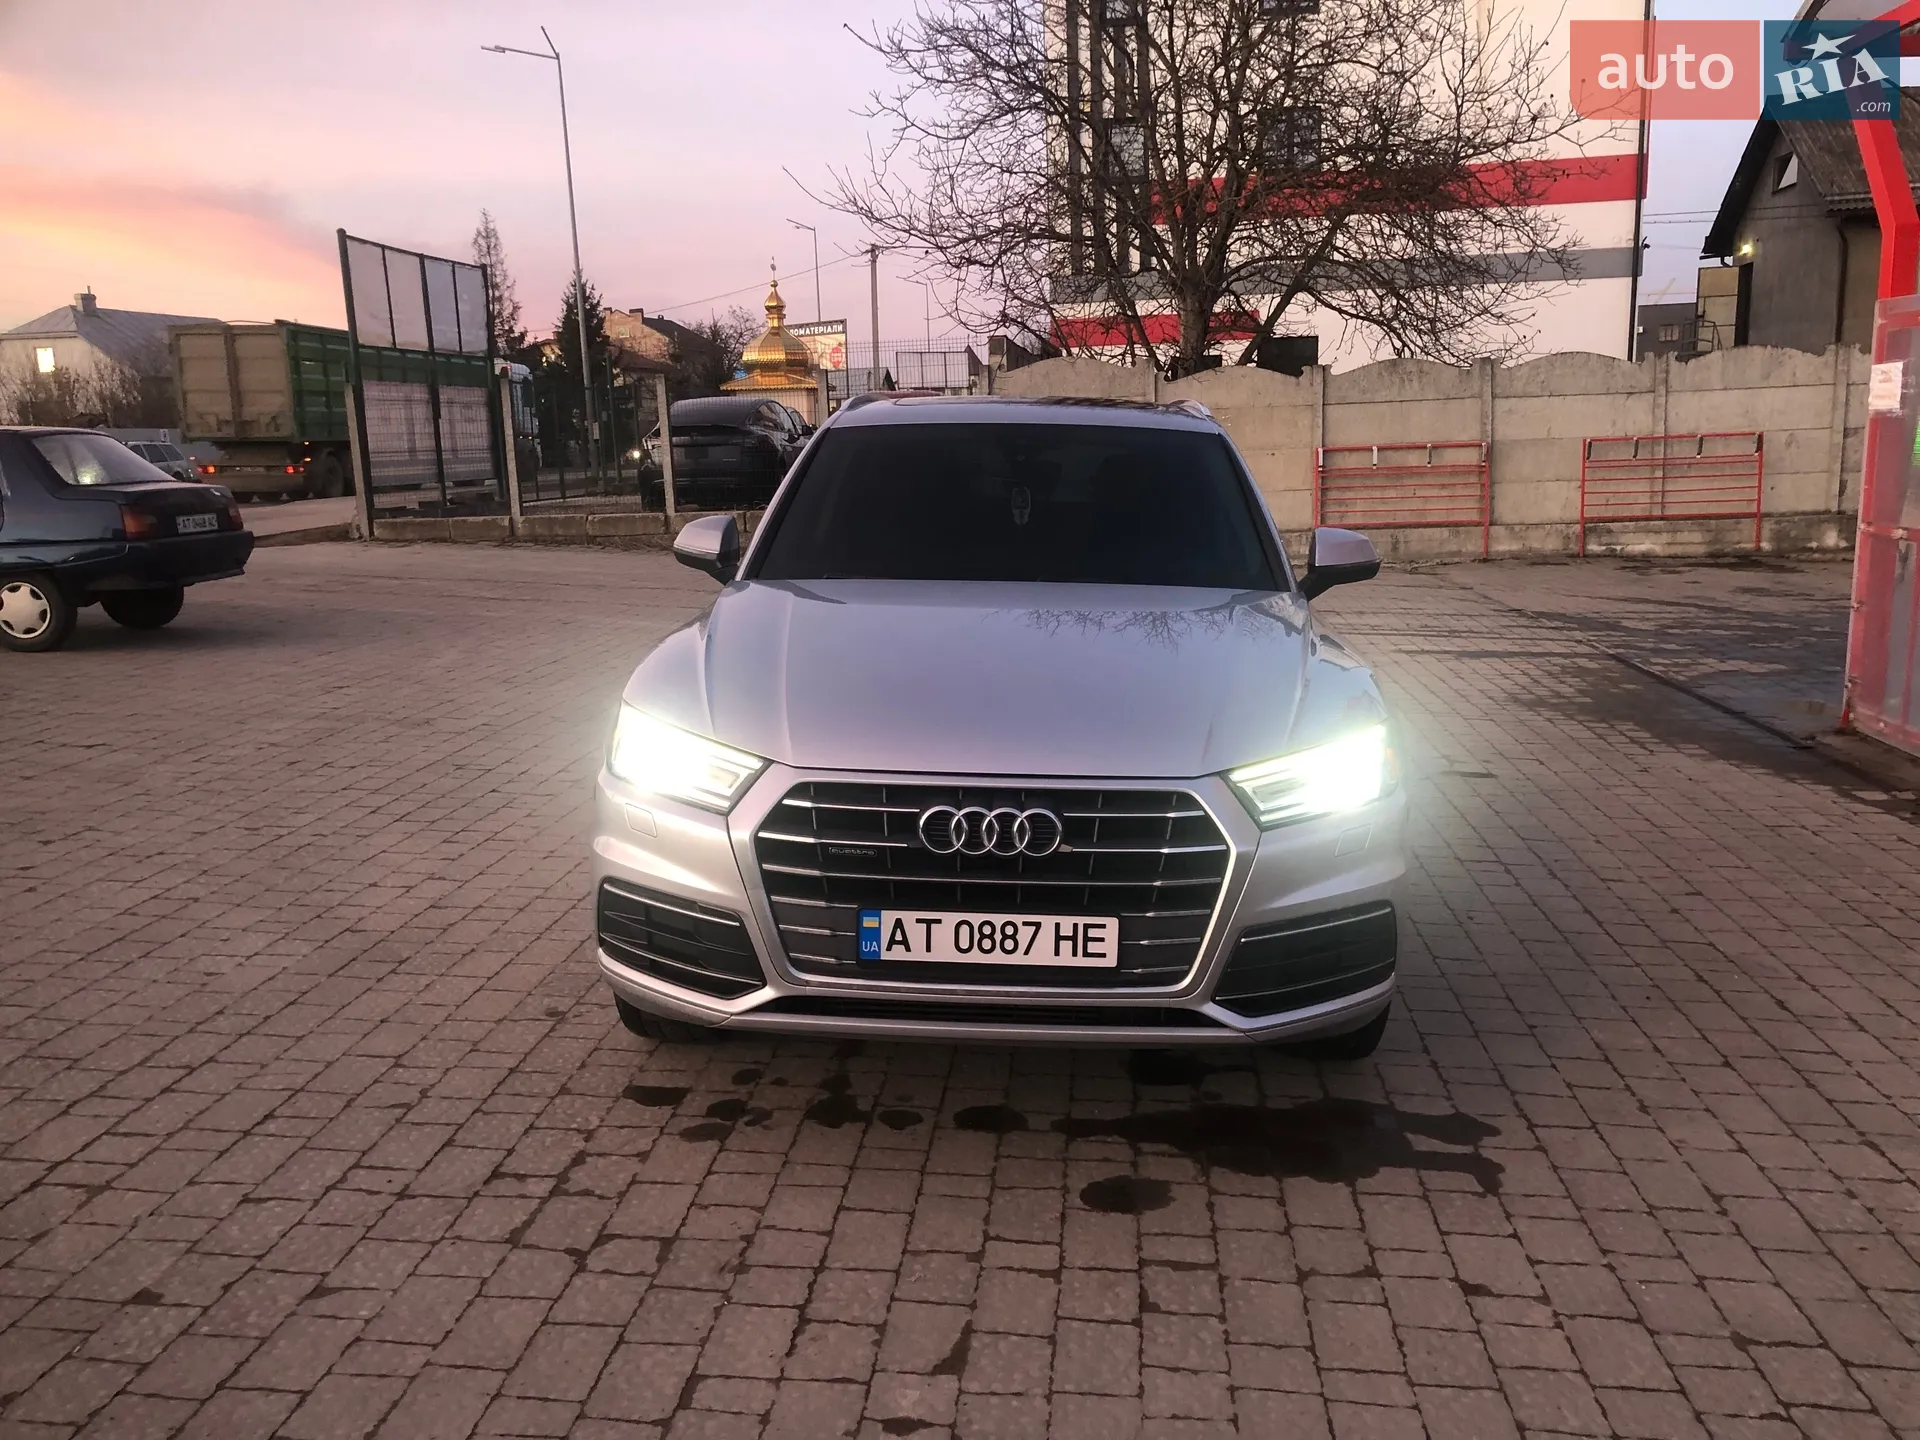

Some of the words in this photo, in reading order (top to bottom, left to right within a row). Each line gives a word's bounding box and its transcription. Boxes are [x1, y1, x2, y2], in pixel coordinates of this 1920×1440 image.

[862, 940, 879, 952] UA
[885, 917, 943, 953] AT
[953, 919, 1042, 956] 0887
[1053, 921, 1107, 958] HE
